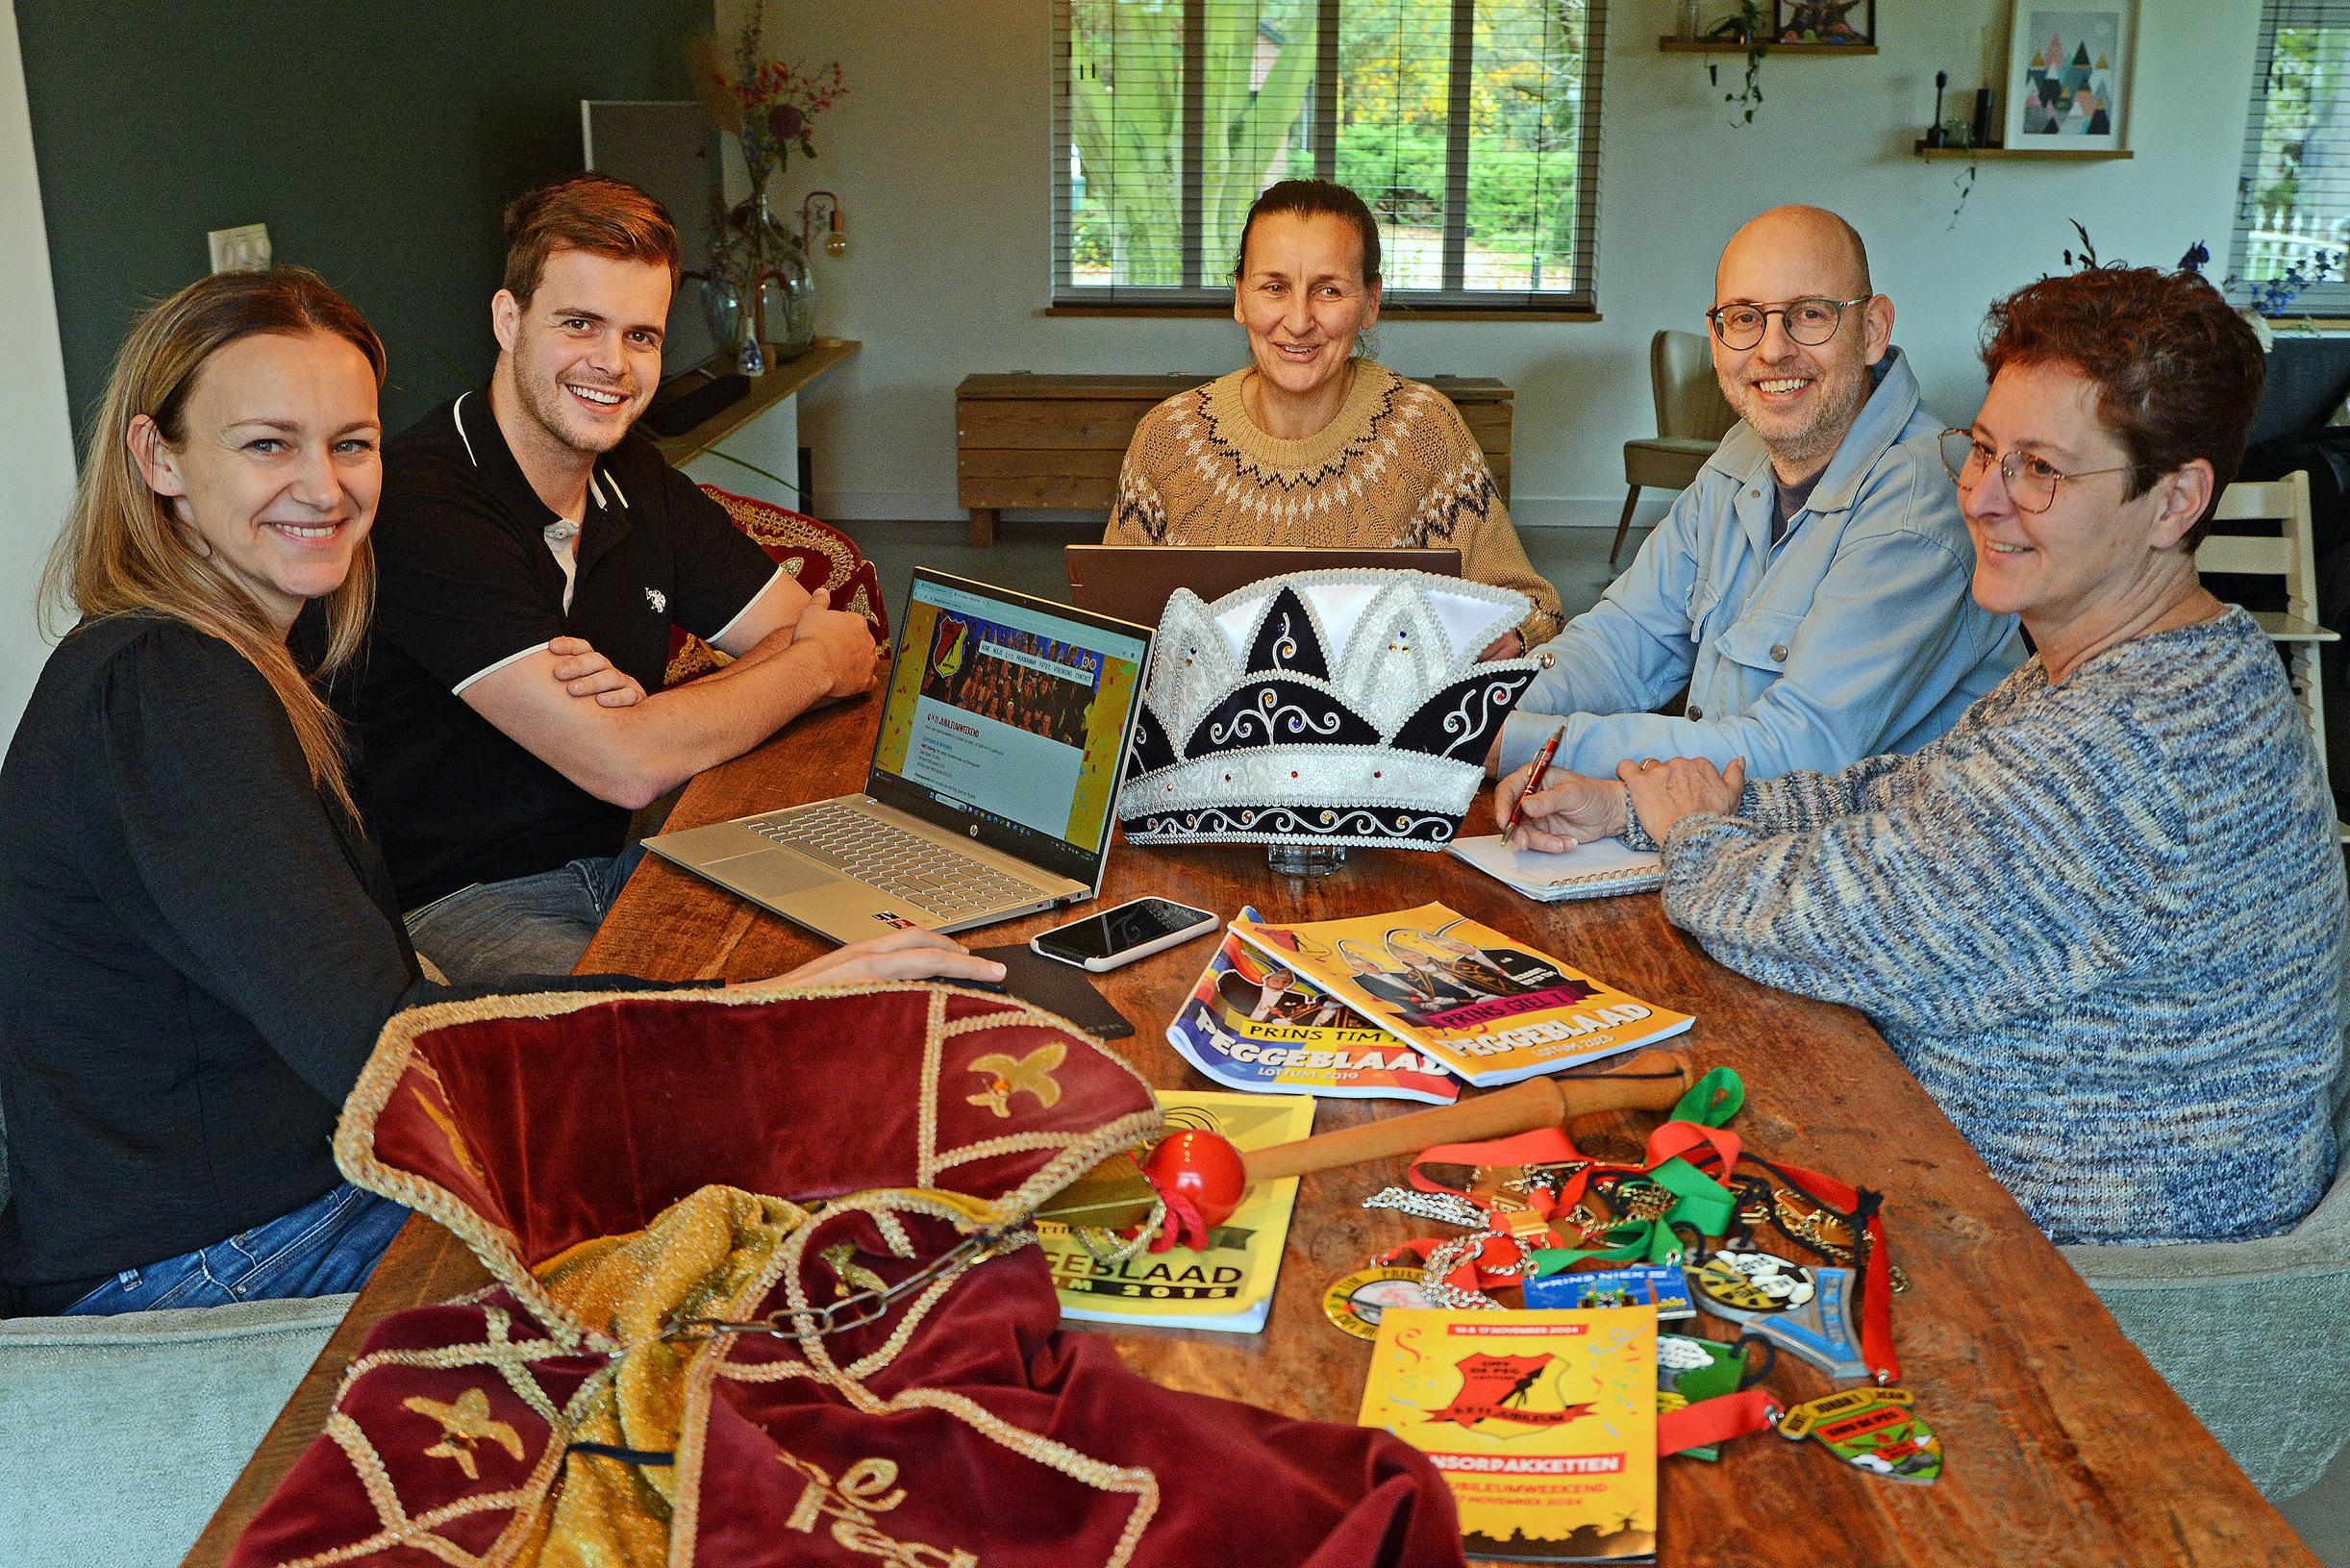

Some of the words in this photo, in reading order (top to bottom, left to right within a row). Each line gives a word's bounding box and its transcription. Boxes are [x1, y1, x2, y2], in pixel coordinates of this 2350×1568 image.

[1441, 1005, 1506, 1027] PRINS
[1505, 995, 1553, 1011] GIEL
[1194, 1006, 1451, 1077] PEGGEBLAAD
[1250, 1025, 1323, 1040] PRINS
[1337, 1031, 1381, 1042] TIM
[1435, 1004, 1653, 1058] PEGGEBLAAD
[1258, 1067, 1317, 1079] LOTTUM
[1429, 1454, 1620, 1474] NSORPAKKETTEN
